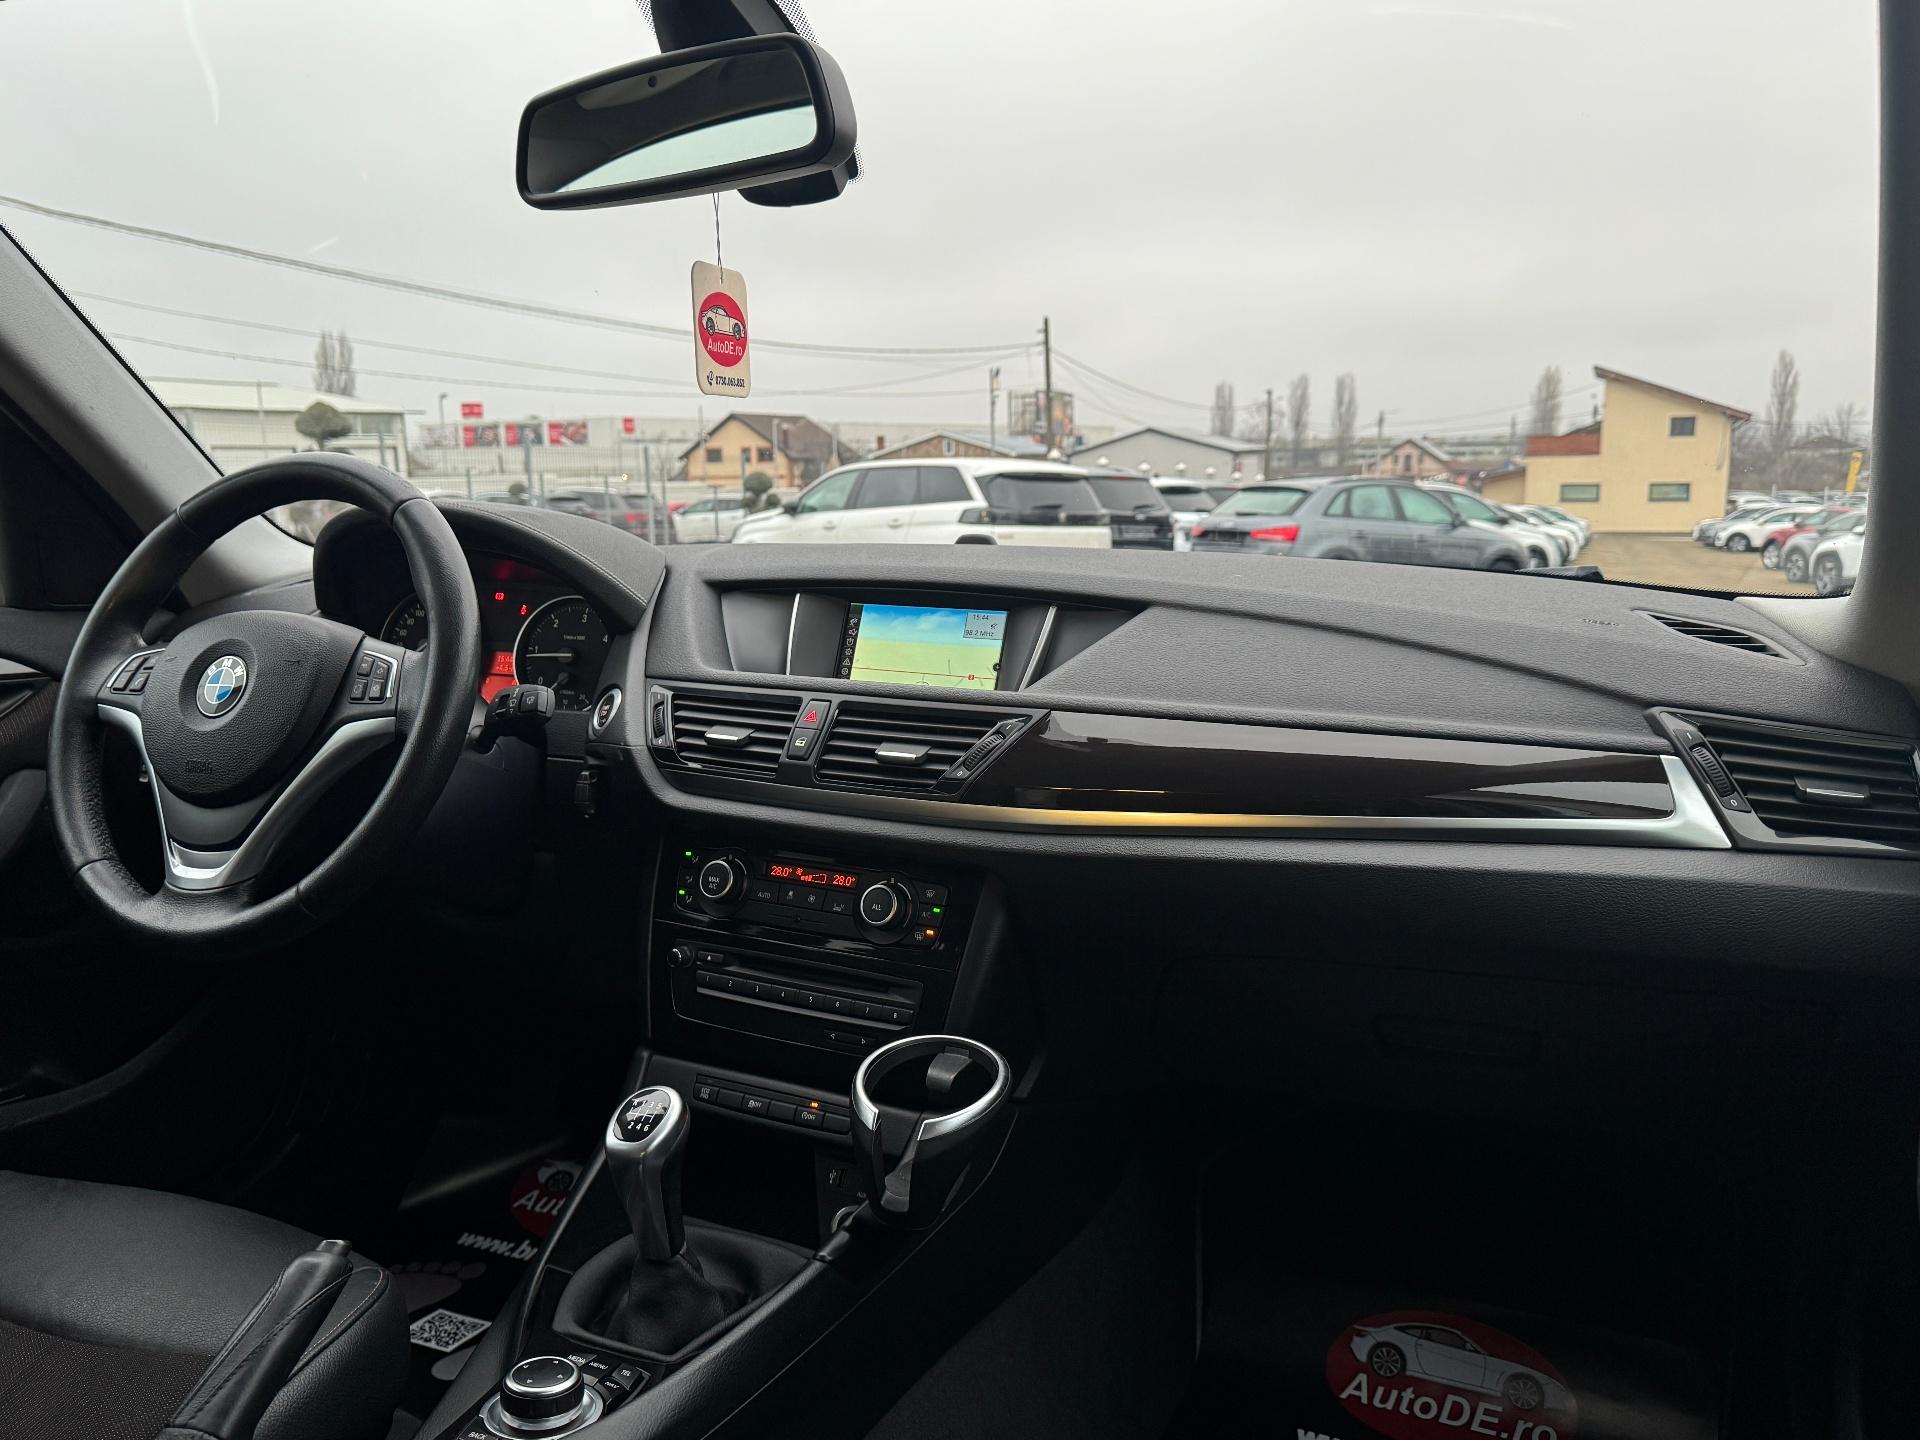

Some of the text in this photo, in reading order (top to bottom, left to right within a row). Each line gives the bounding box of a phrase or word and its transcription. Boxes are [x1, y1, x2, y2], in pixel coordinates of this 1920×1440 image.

[707, 338, 743, 356] AutoDE.ro
[582, 614, 588, 623] 3
[553, 619, 559, 628] 2
[965, 629, 994, 638] 98.2 MHz
[602, 634, 608, 643] 4
[207, 658, 244, 678] BMW
[538, 676, 544, 685] 0
[708, 876, 720, 884] MAX
[757, 891, 771, 900] AUTO
[871, 903, 882, 911] ALL
[627, 1121, 650, 1132] 2 4 6
[567, 1354, 586, 1364] MEDIA
[588, 1361, 609, 1370] MENU
[620, 1369, 631, 1377] TEL
[604, 1381, 620, 1389] NAV
[468, 1431, 487, 1440] BACK
